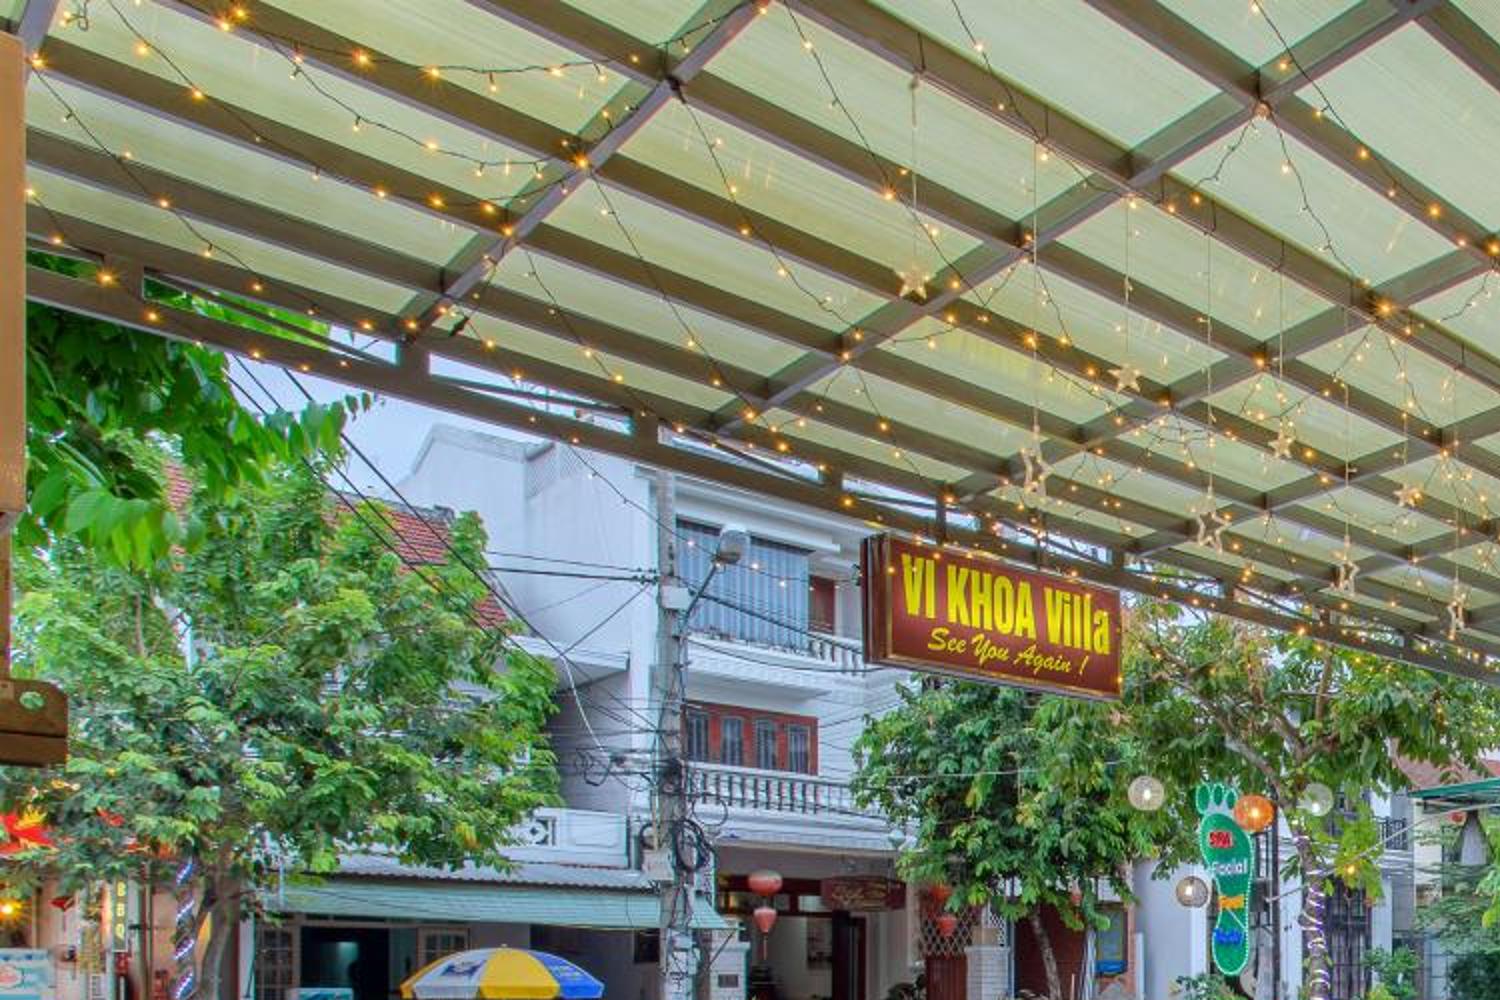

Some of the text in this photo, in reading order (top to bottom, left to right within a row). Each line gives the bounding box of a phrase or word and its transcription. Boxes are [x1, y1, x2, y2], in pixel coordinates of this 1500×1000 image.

[902, 553, 1111, 656] VI KHOA Villa
[928, 626, 1090, 676] See You Again !
